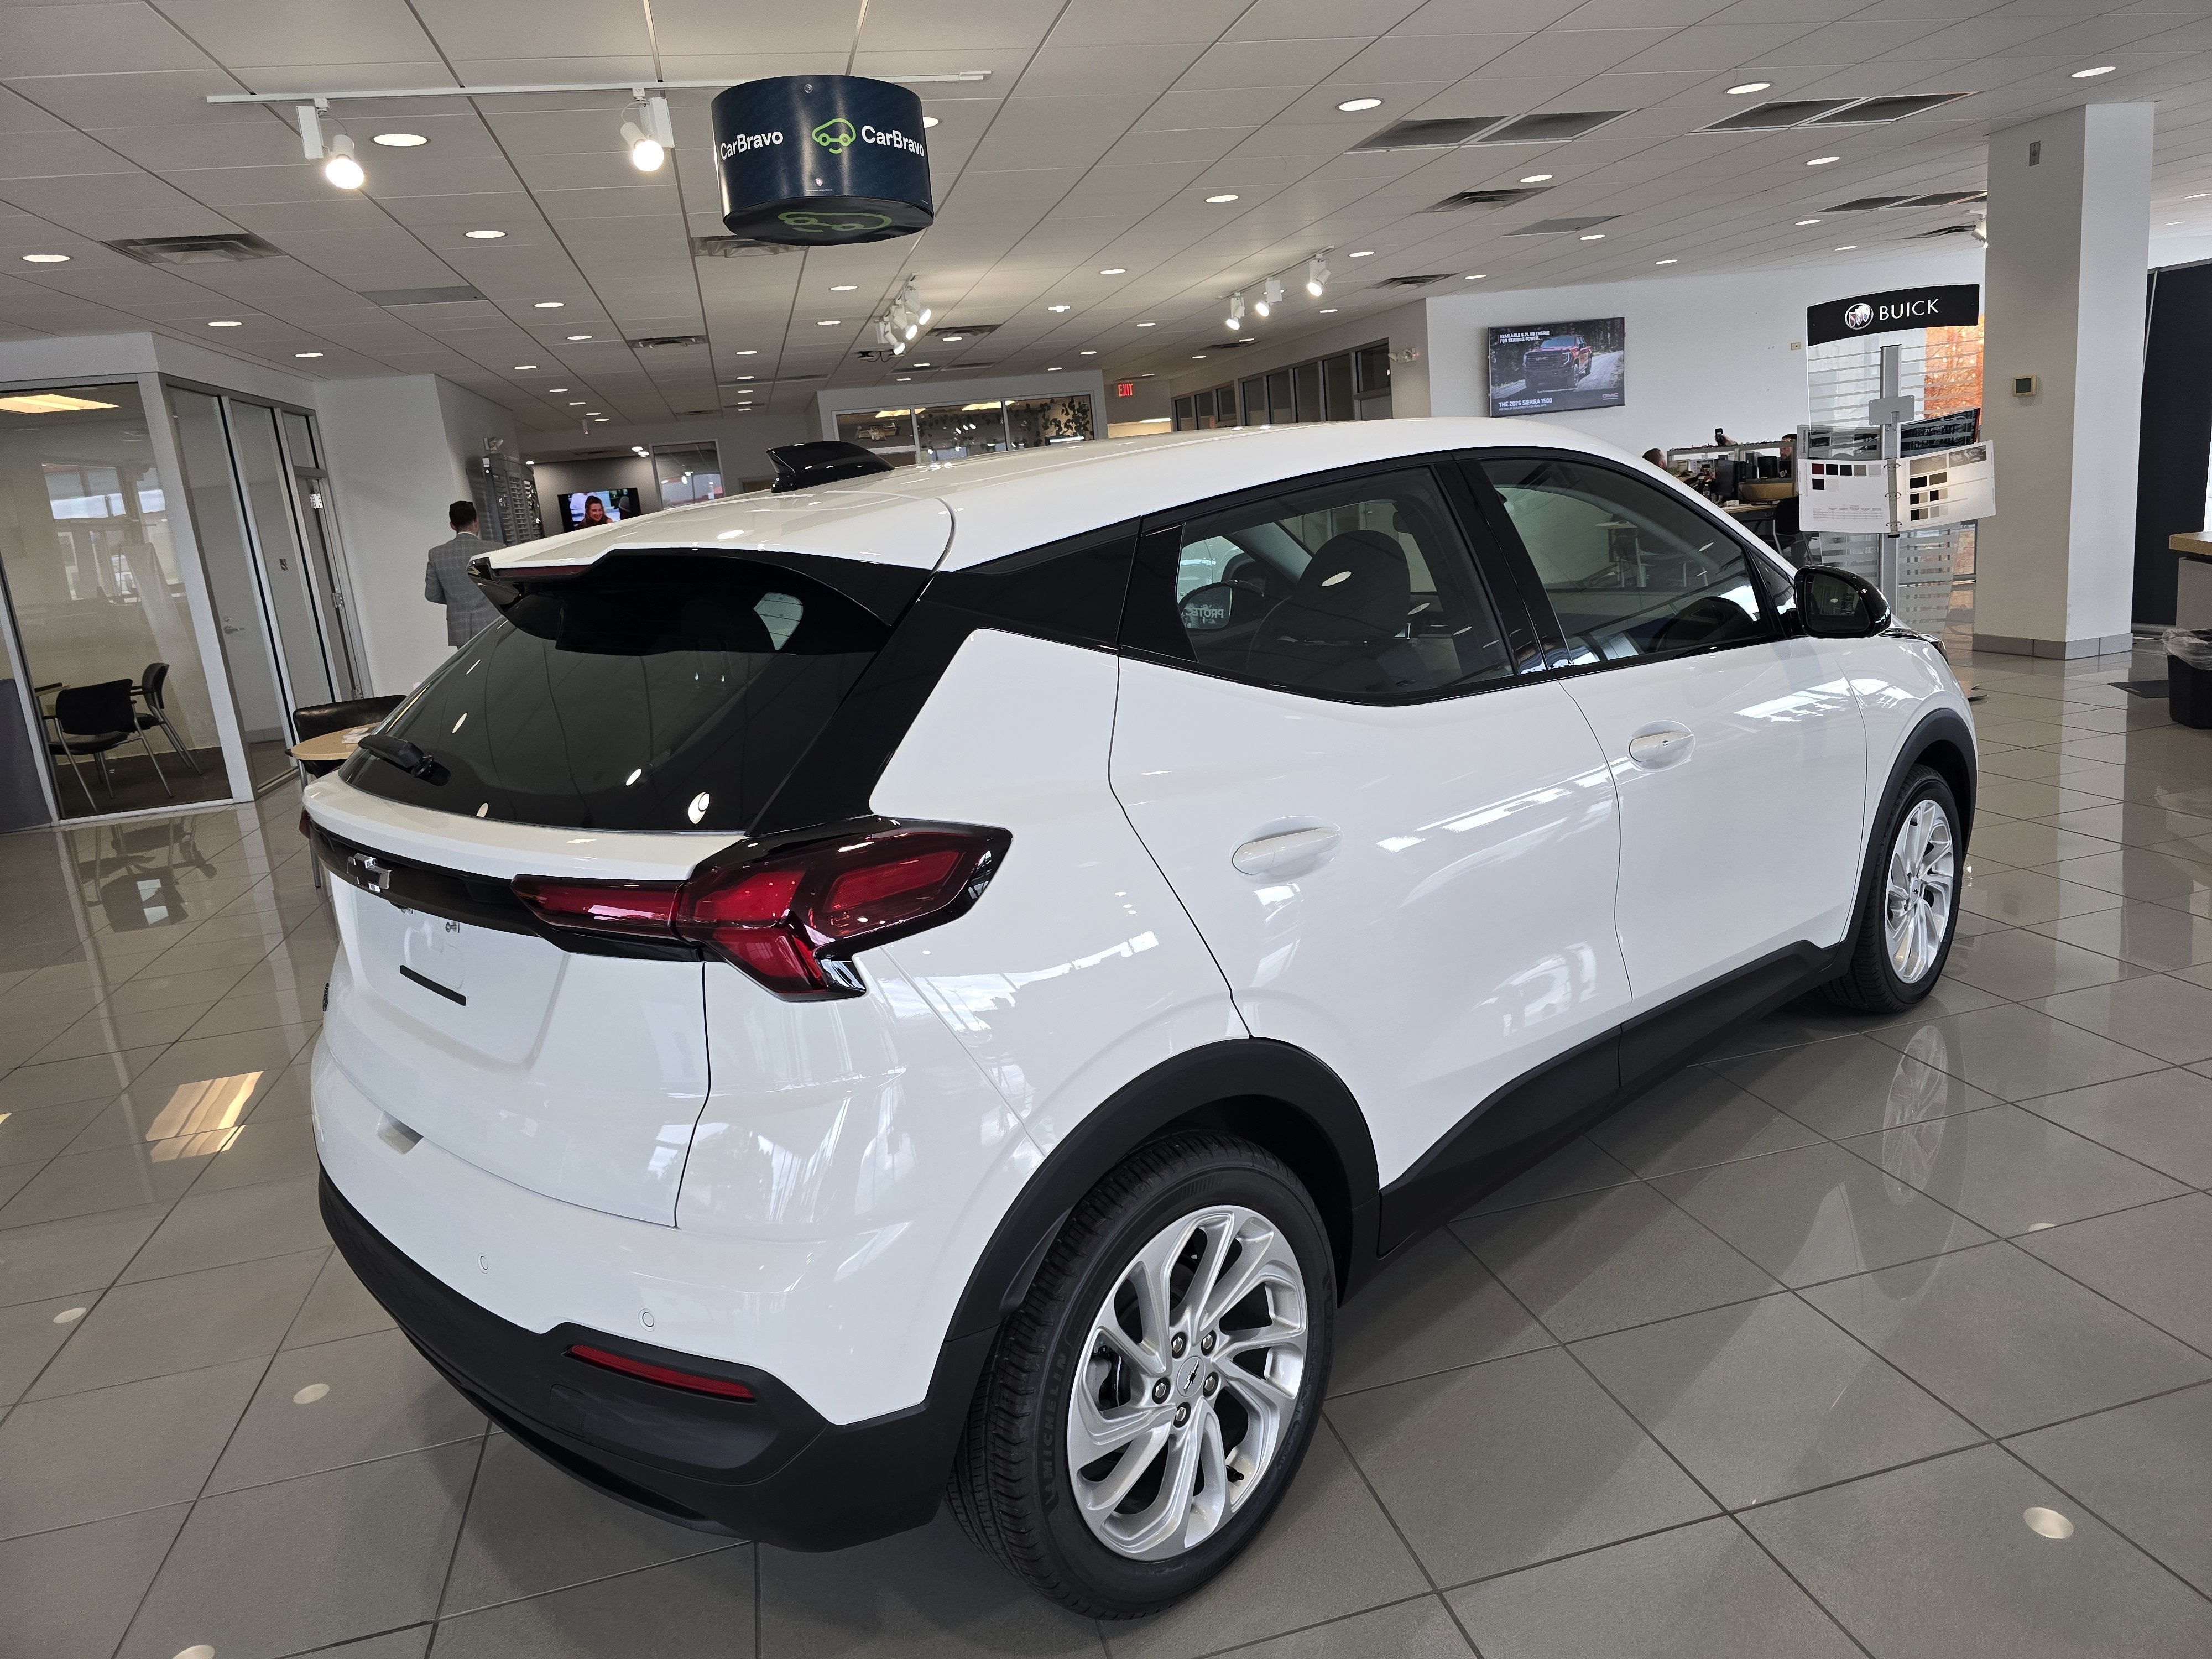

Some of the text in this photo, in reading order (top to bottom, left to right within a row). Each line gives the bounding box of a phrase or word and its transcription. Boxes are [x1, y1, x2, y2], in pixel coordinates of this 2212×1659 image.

[721, 131, 784, 160] CarBravo
[861, 126, 925, 158] CarBravo
[1879, 299, 1939, 321] BUICK
[1118, 383, 1133, 397] EXIT
[1925, 425, 1945, 433] TERRAIN
[1043, 1353, 1067, 1479] MICHELIN
